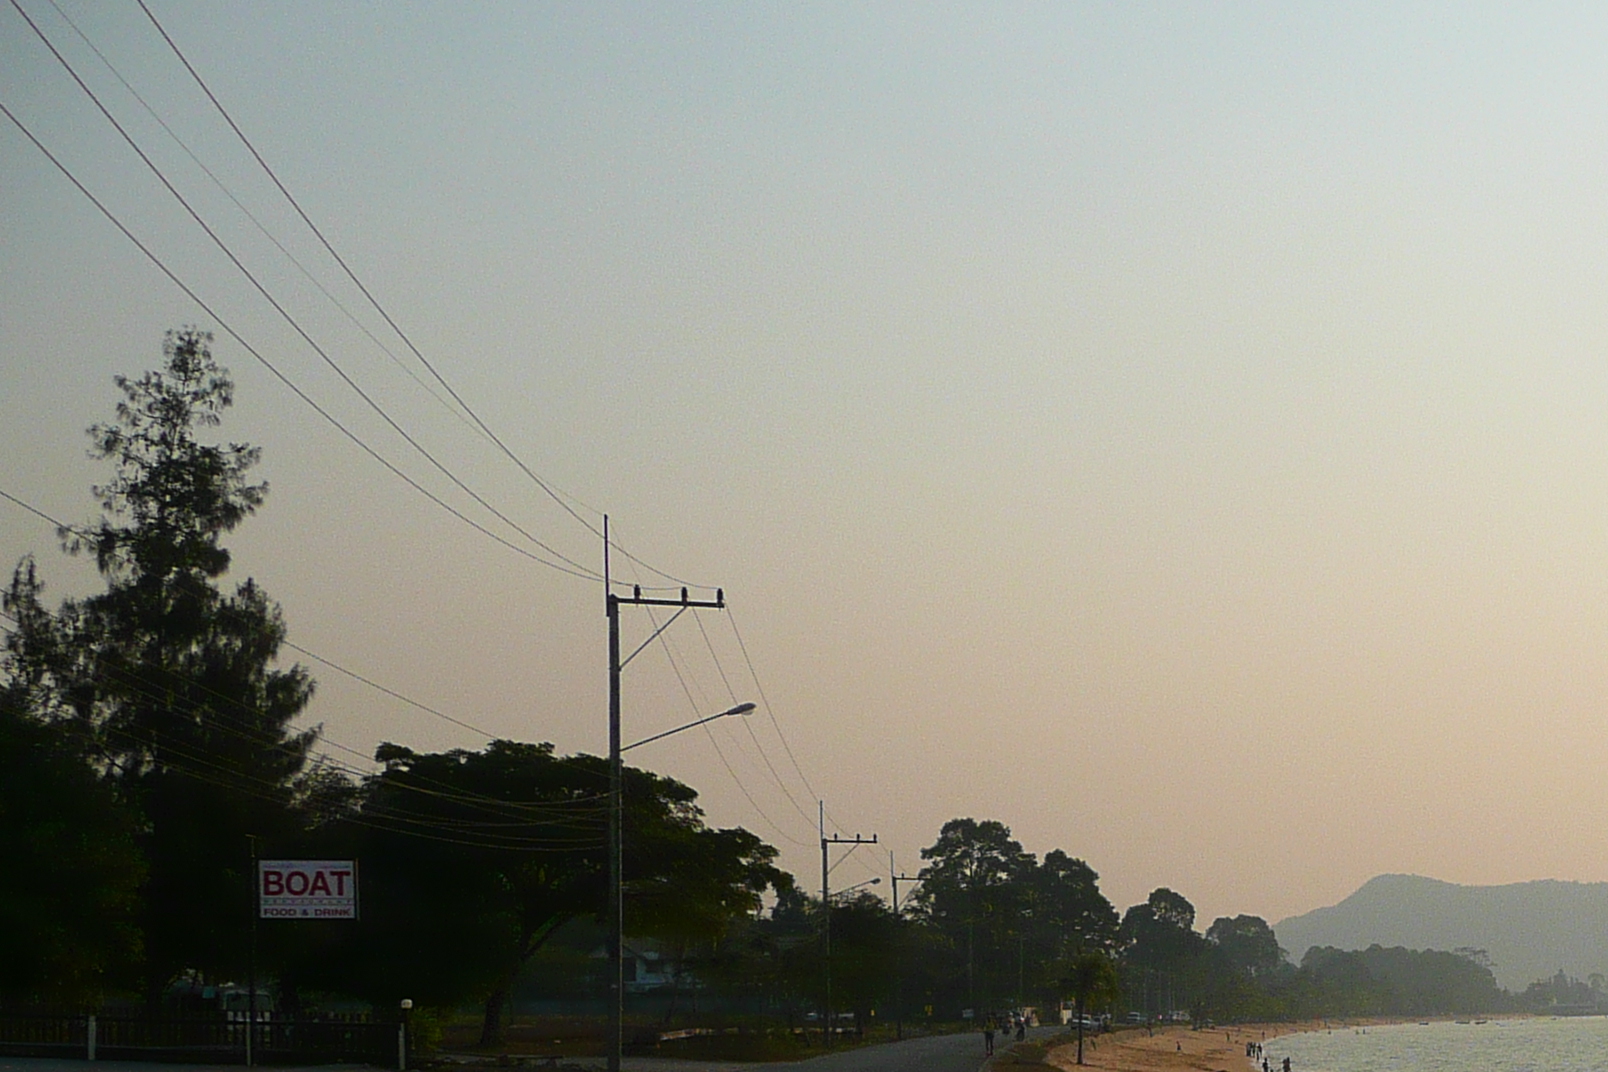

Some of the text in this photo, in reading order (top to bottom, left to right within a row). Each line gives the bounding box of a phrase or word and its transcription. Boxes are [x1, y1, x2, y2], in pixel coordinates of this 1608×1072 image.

[263, 870, 351, 896] BOAT
[263, 908, 351, 917] FOOD & DRINK
